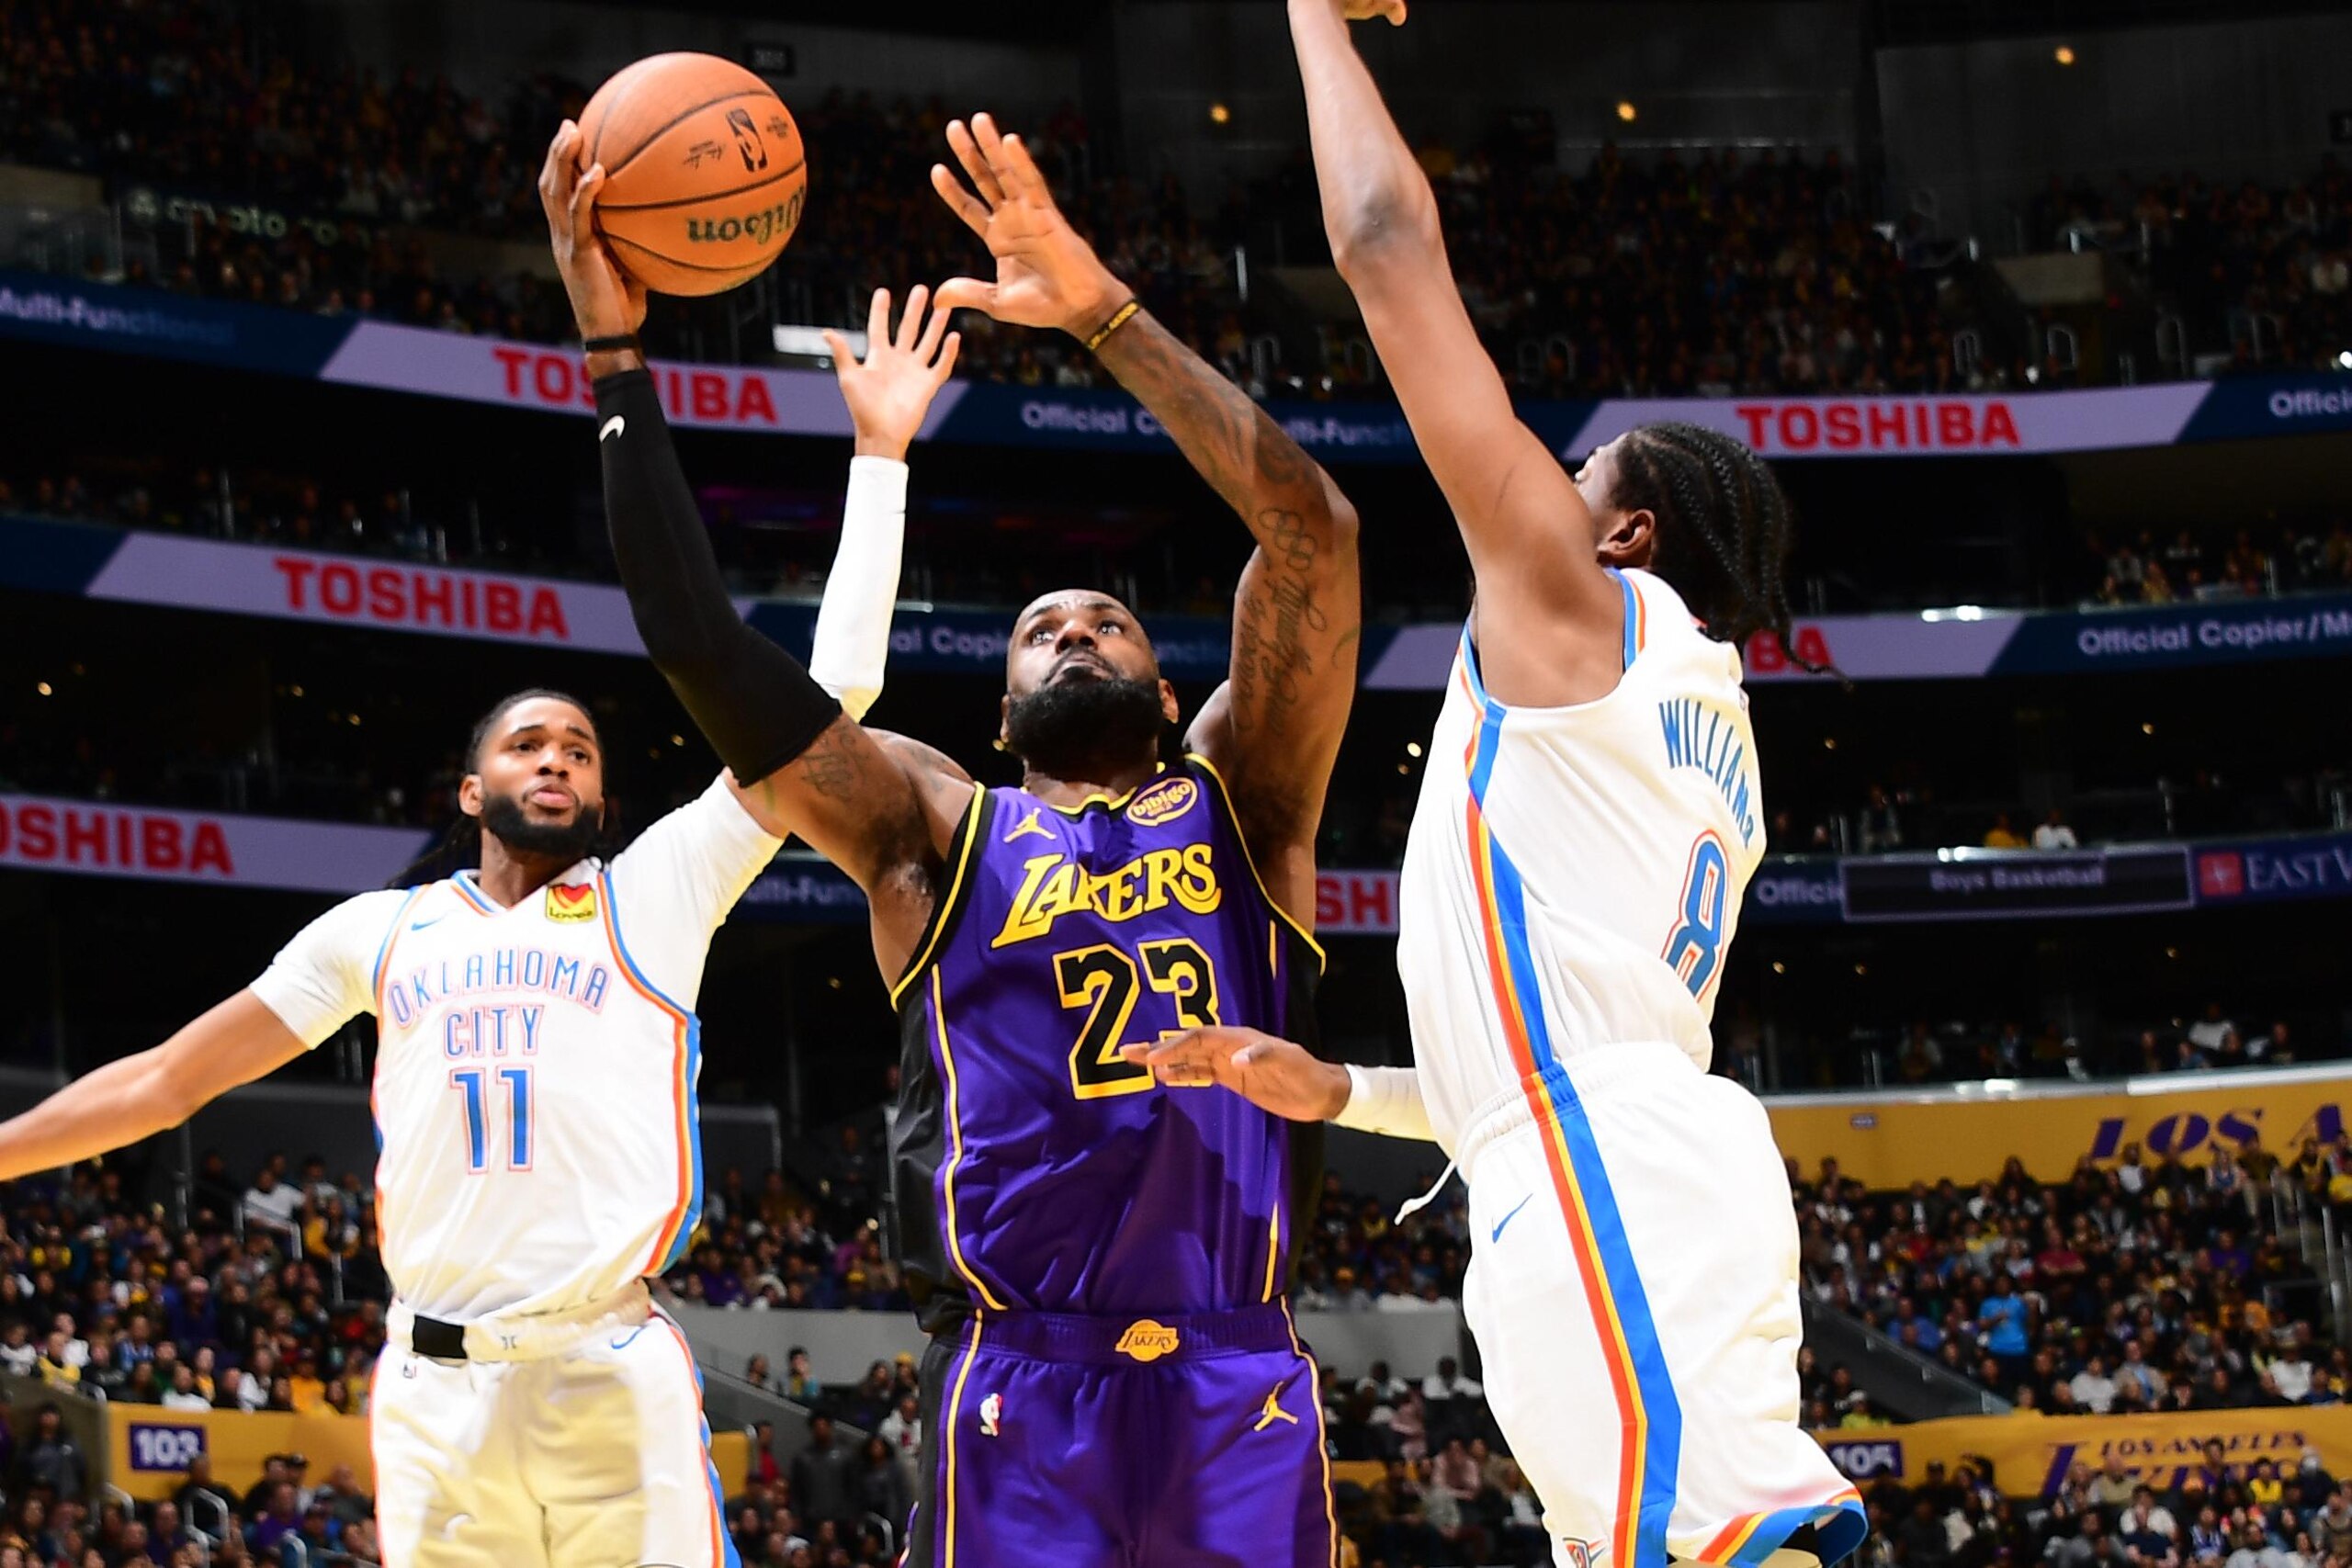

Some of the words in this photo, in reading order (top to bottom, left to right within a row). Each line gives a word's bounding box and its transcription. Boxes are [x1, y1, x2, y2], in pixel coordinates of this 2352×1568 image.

[492, 346, 778, 425] TOIBA
[1736, 401, 2020, 449] TOSHIBA
[2268, 388, 2352, 419] Offici
[275, 557, 570, 639] TOSHIBA
[2077, 620, 2193, 657] Official
[0, 798, 235, 876] SHIBA
[1133, 783, 1191, 817] bibigo
[990, 842, 1222, 948] LAKERS
[1659, 829, 1730, 1004] 8
[387, 948, 611, 1030] OKLAHOMA
[1051, 937, 1222, 1100] 23
[443, 1005, 545, 1060] CITY
[449, 1064, 534, 1175] 11
